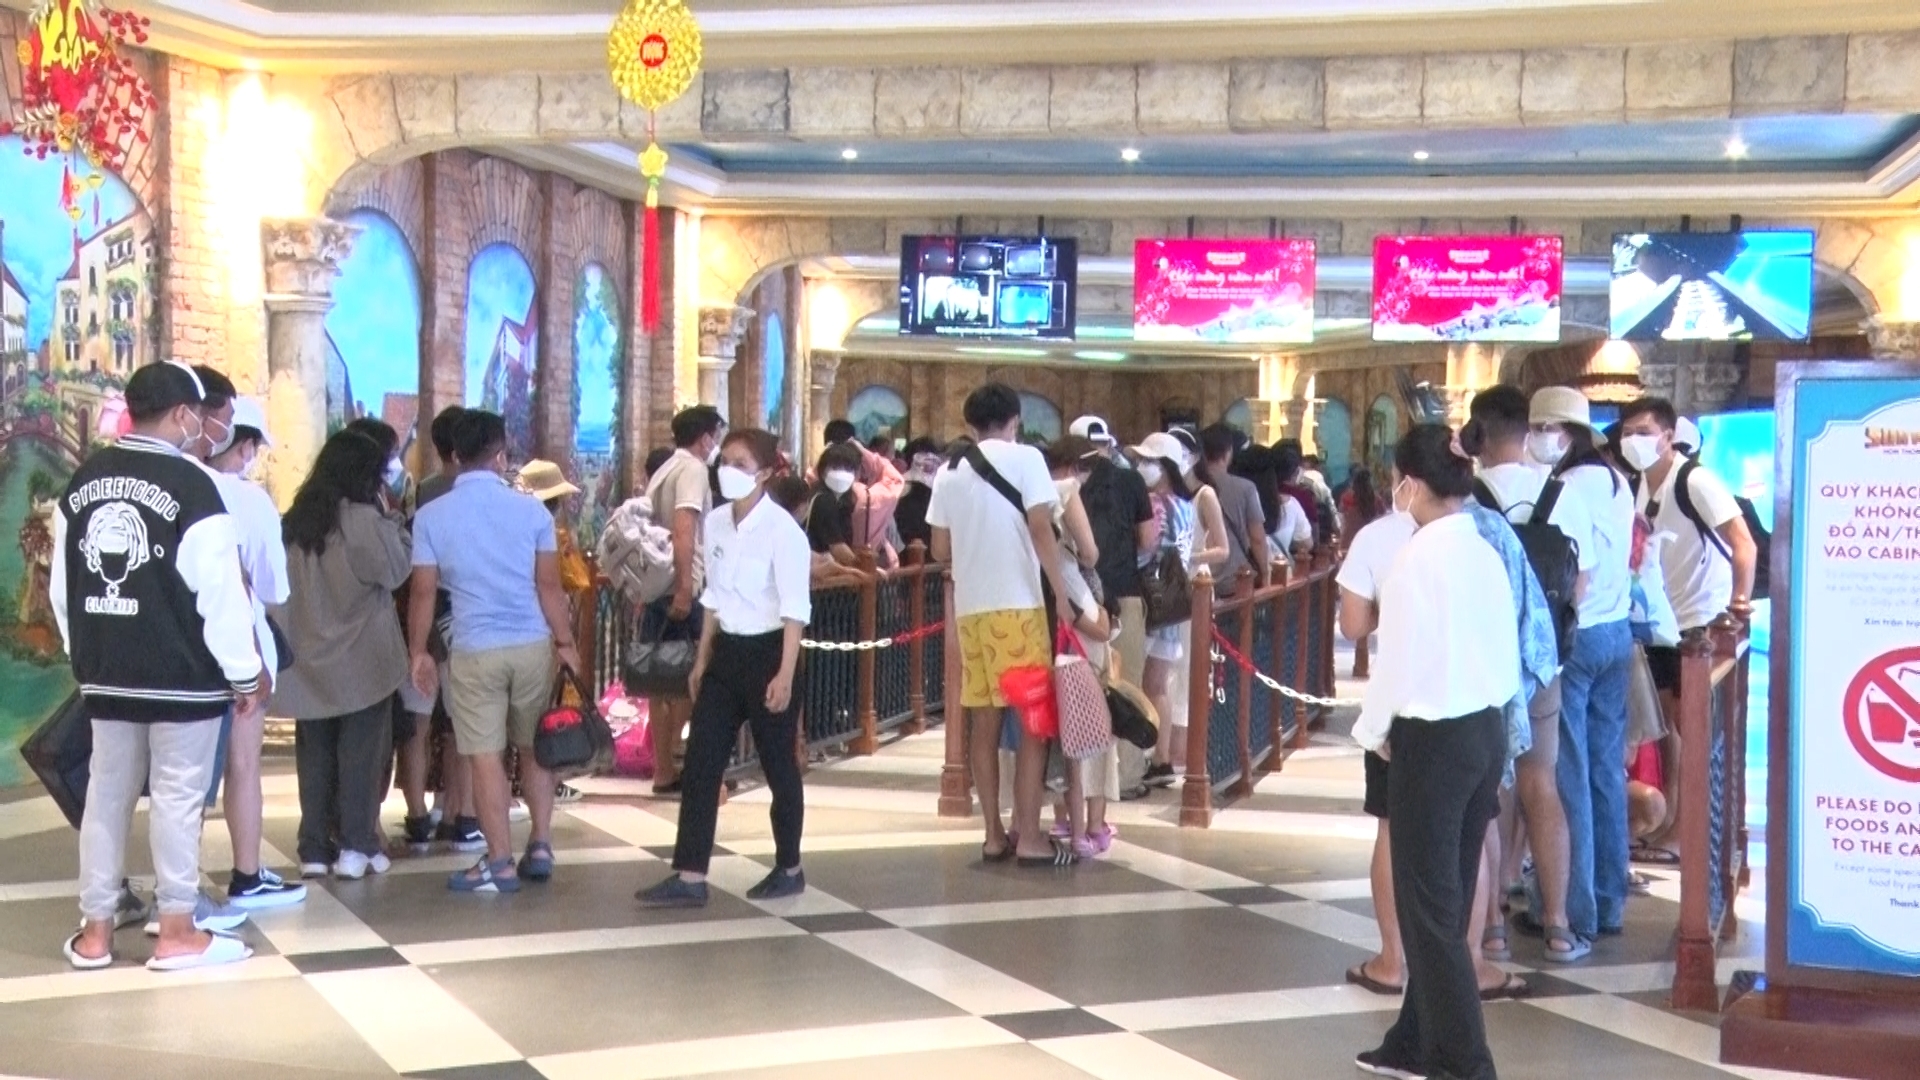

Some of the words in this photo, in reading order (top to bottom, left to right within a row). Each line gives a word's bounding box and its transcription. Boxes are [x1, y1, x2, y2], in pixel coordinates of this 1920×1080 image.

[1867, 482, 1920, 499] KHÁC
[1816, 796, 1878, 813] PLEASE
[1884, 800, 1912, 815] DO
[1826, 816, 1889, 833] FOODS
[1832, 838, 1854, 851] TO
[1860, 840, 1892, 855] THE
